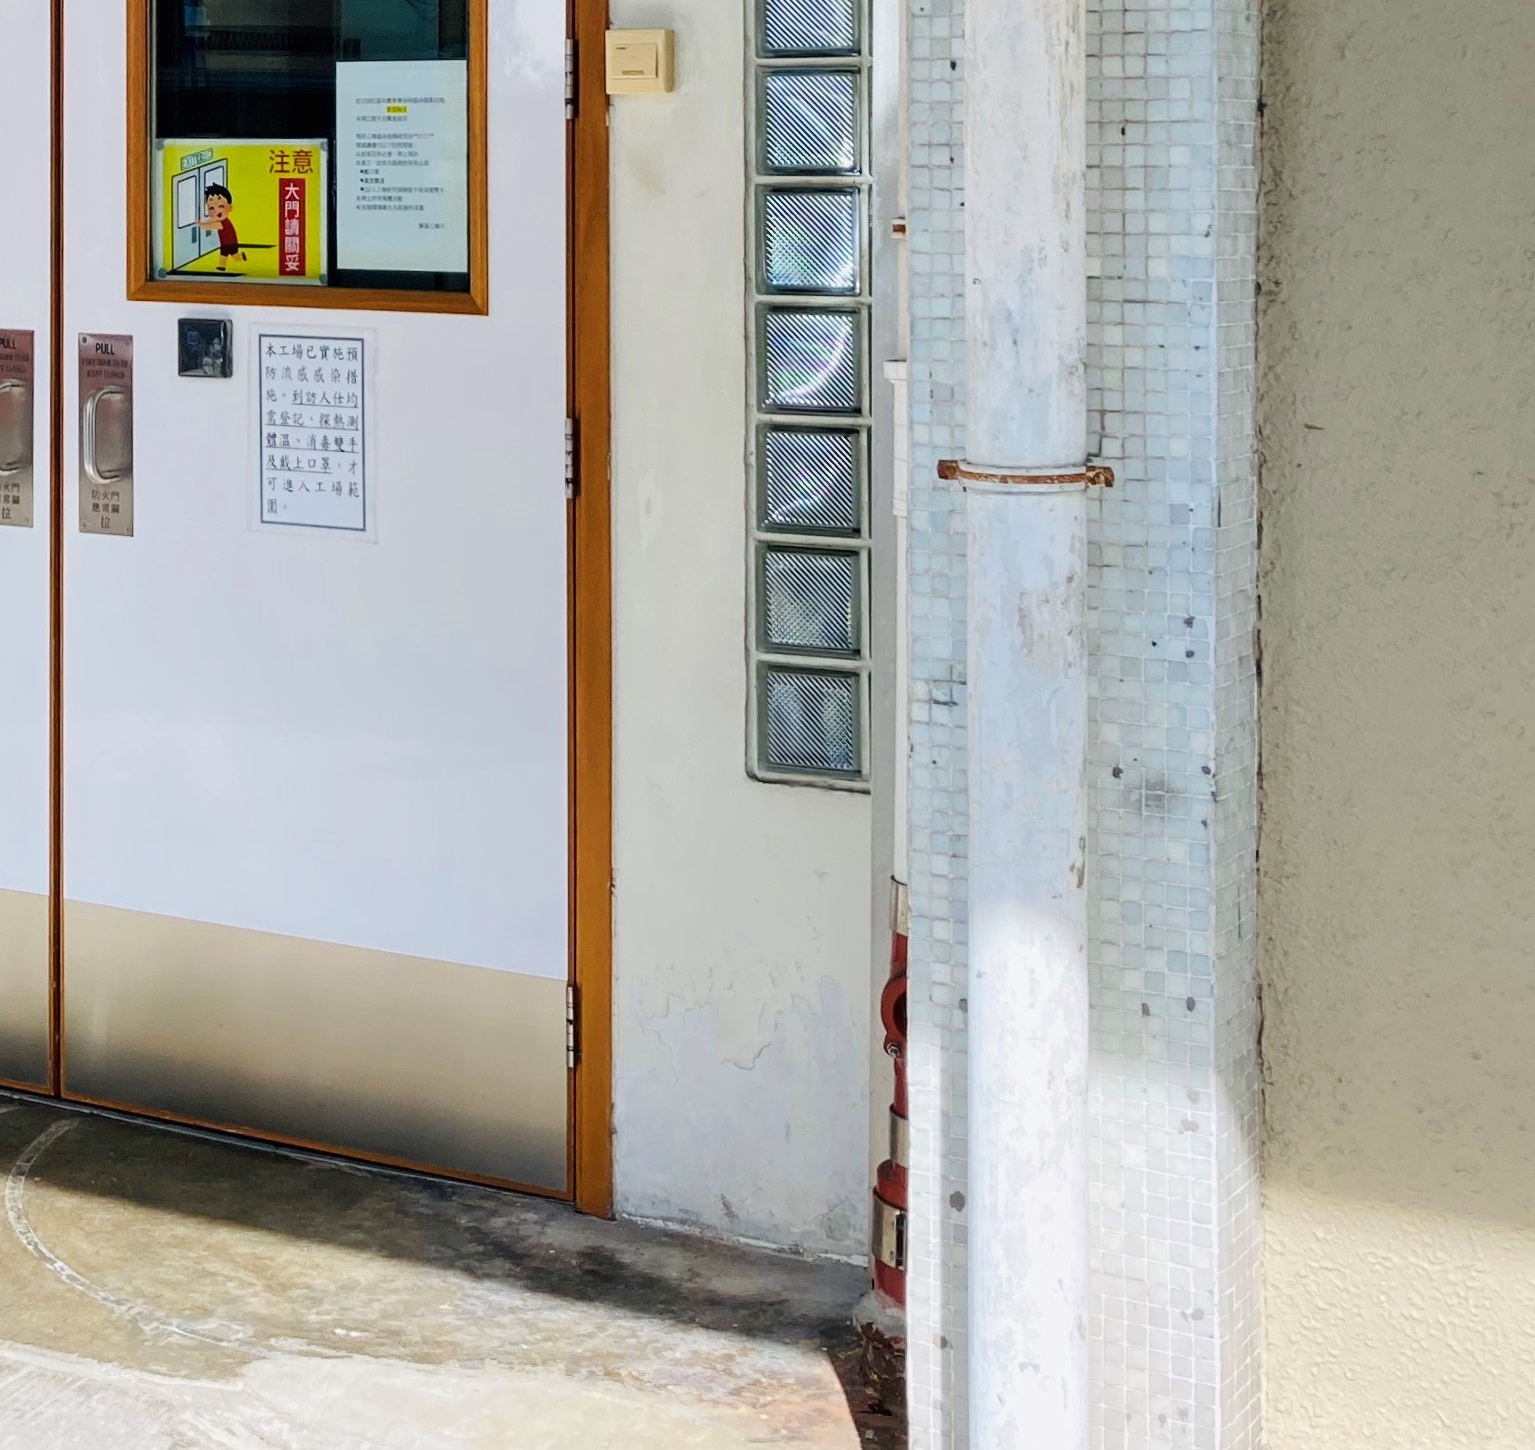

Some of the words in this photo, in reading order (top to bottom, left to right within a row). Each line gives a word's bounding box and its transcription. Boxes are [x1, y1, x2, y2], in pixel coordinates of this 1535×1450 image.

[269, 149, 314, 175] 注意
[95, 342, 116, 356] PULL
[265, 342, 359, 361] 本工場已實施預
[267, 477, 360, 498] 可進入工場範
[91, 489, 120, 501] 防火門
[1, 506, 12, 520] 拉
[100, 515, 111, 529] 拉
